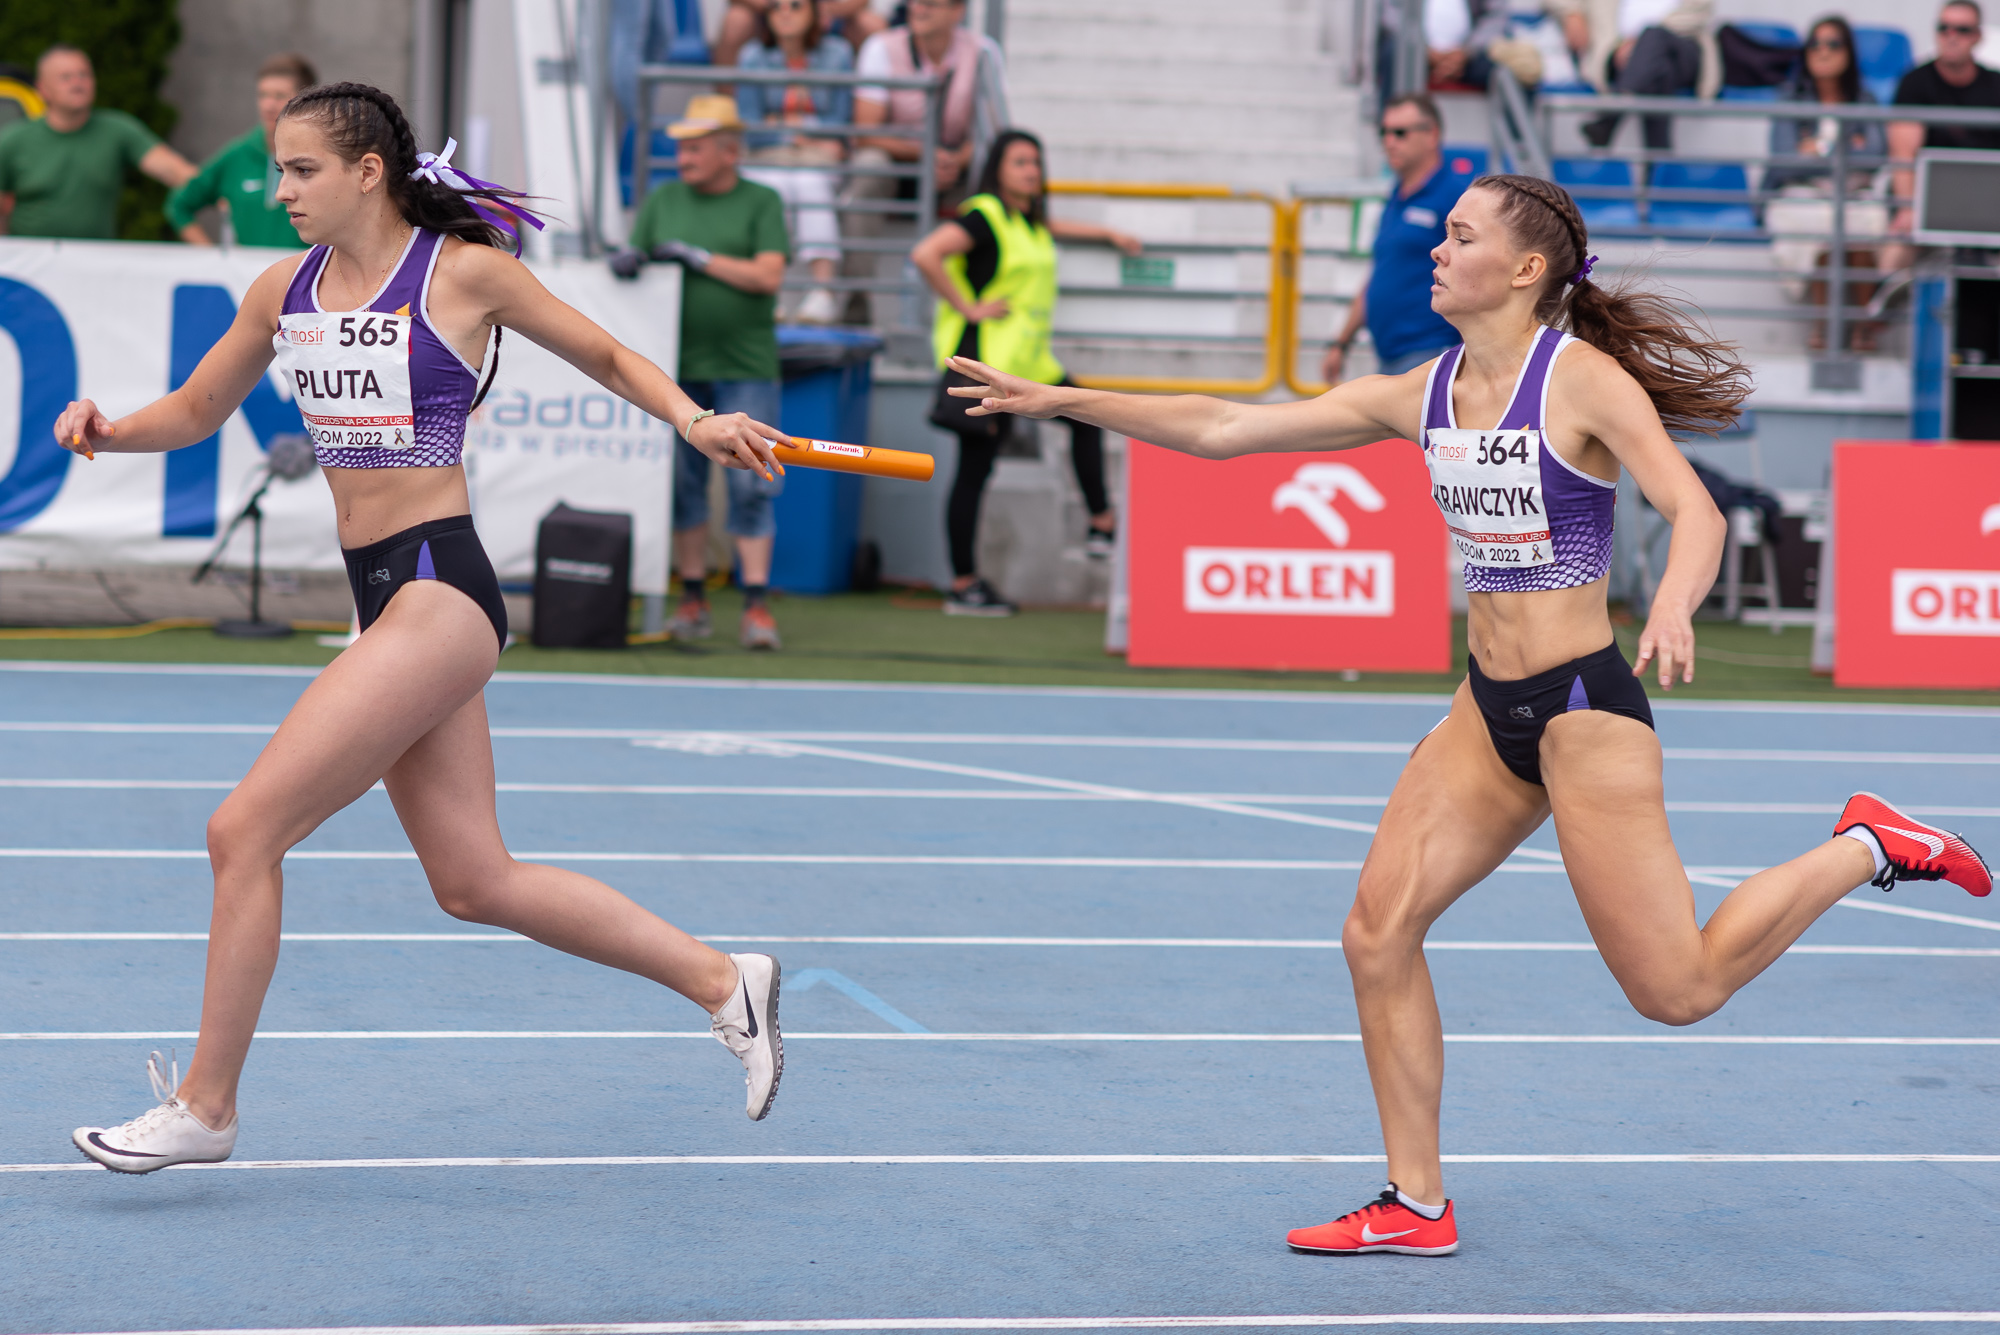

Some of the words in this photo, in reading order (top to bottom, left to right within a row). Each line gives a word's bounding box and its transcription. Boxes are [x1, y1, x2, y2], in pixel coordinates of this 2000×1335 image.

[290, 326, 326, 343] mosir
[339, 317, 400, 347] 565
[294, 368, 384, 399] PLUTA
[307, 414, 355, 426] STRZOSTWA
[356, 417, 388, 426] POLSKI
[390, 416, 410, 425] U20
[347, 431, 384, 446] 2022
[828, 444, 860, 454] polanik
[1439, 443, 1469, 459] mosir
[1476, 435, 1530, 466] 564
[1433, 483, 1540, 517] KRAWCZYK
[1498, 534, 1524, 543] POLSKI
[1525, 531, 1547, 541] U20
[1489, 547, 1521, 562] 2022
[1200, 562, 1376, 600] ORLEN
